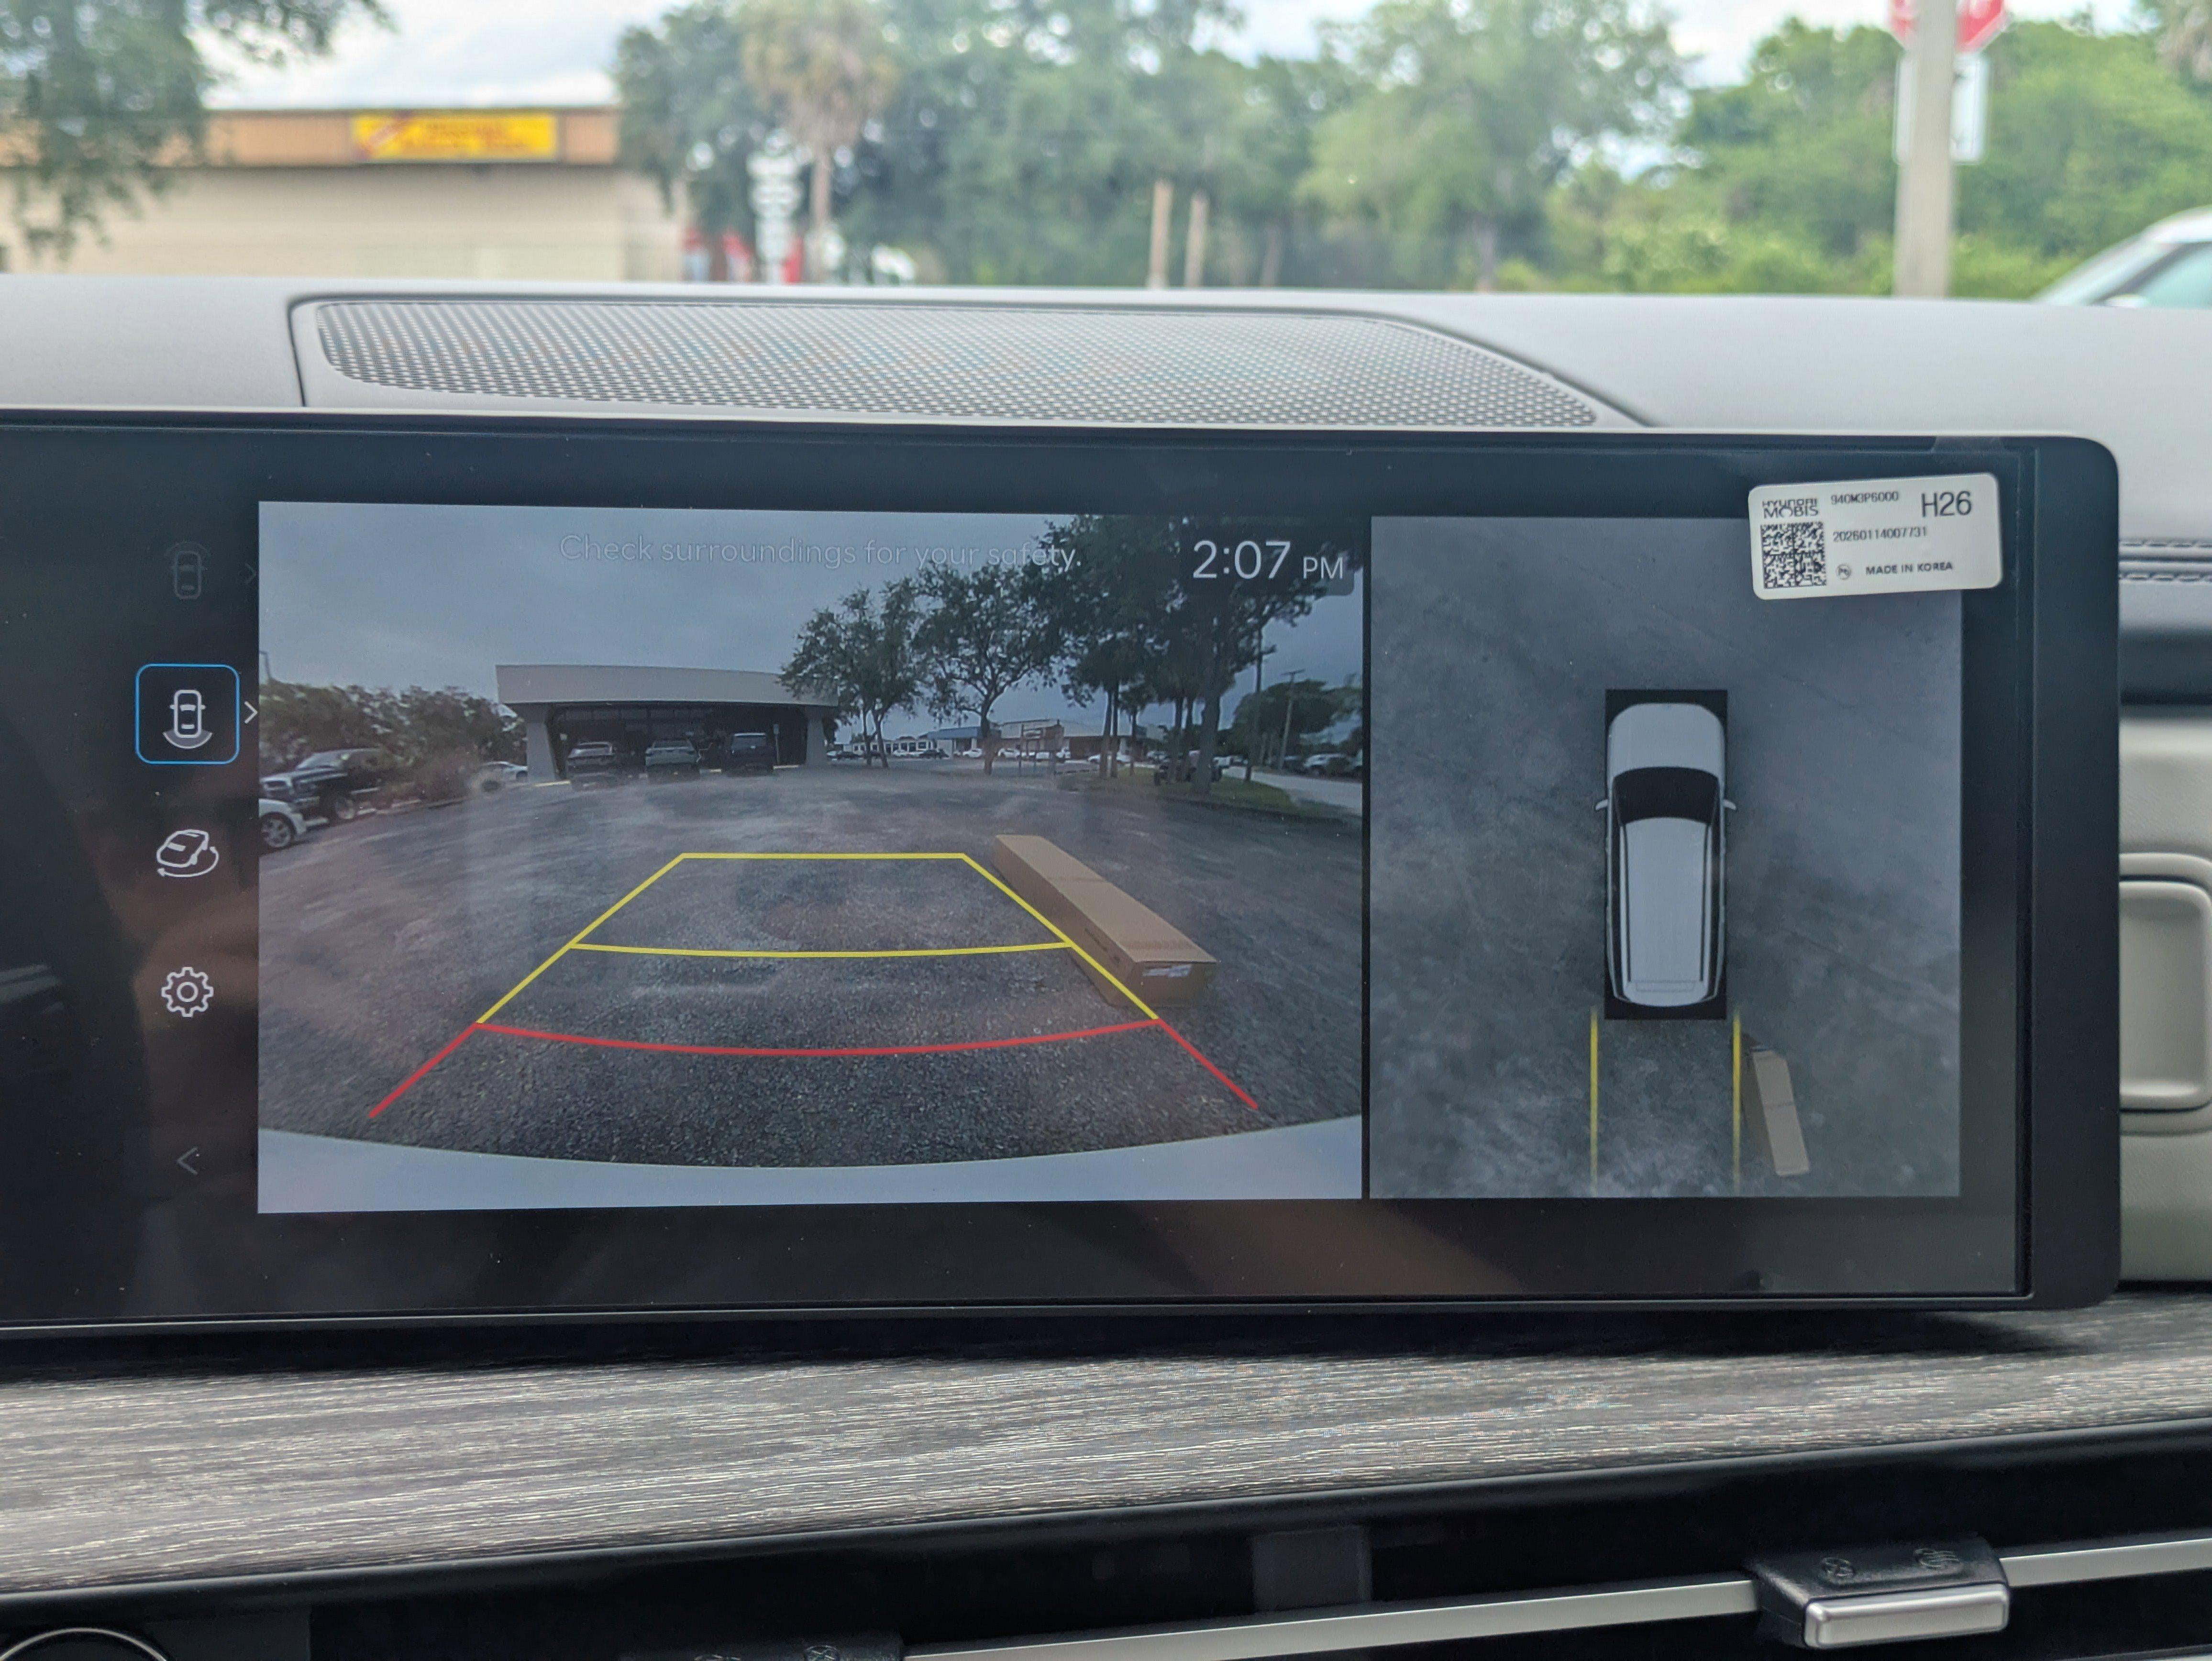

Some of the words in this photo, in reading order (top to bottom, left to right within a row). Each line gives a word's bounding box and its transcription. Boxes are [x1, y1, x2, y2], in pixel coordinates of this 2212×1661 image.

[1762, 498, 1818, 508] HYUNDAI
[1921, 491, 1971, 517] H26
[1763, 505, 1819, 519] MOBIS
[1833, 526, 1926, 543] 20260114007731
[560, 534, 652, 560] Check
[662, 537, 856, 569] surroundings
[864, 540, 907, 564] for
[914, 546, 980, 570] your
[987, 542, 1081, 572] safety.
[1193, 540, 1291, 579] 2:07
[1303, 556, 1343, 579] PM
[1866, 565, 1898, 575] MADE
[1901, 564, 1913, 573] IN
[1917, 562, 1953, 573] KOREA
